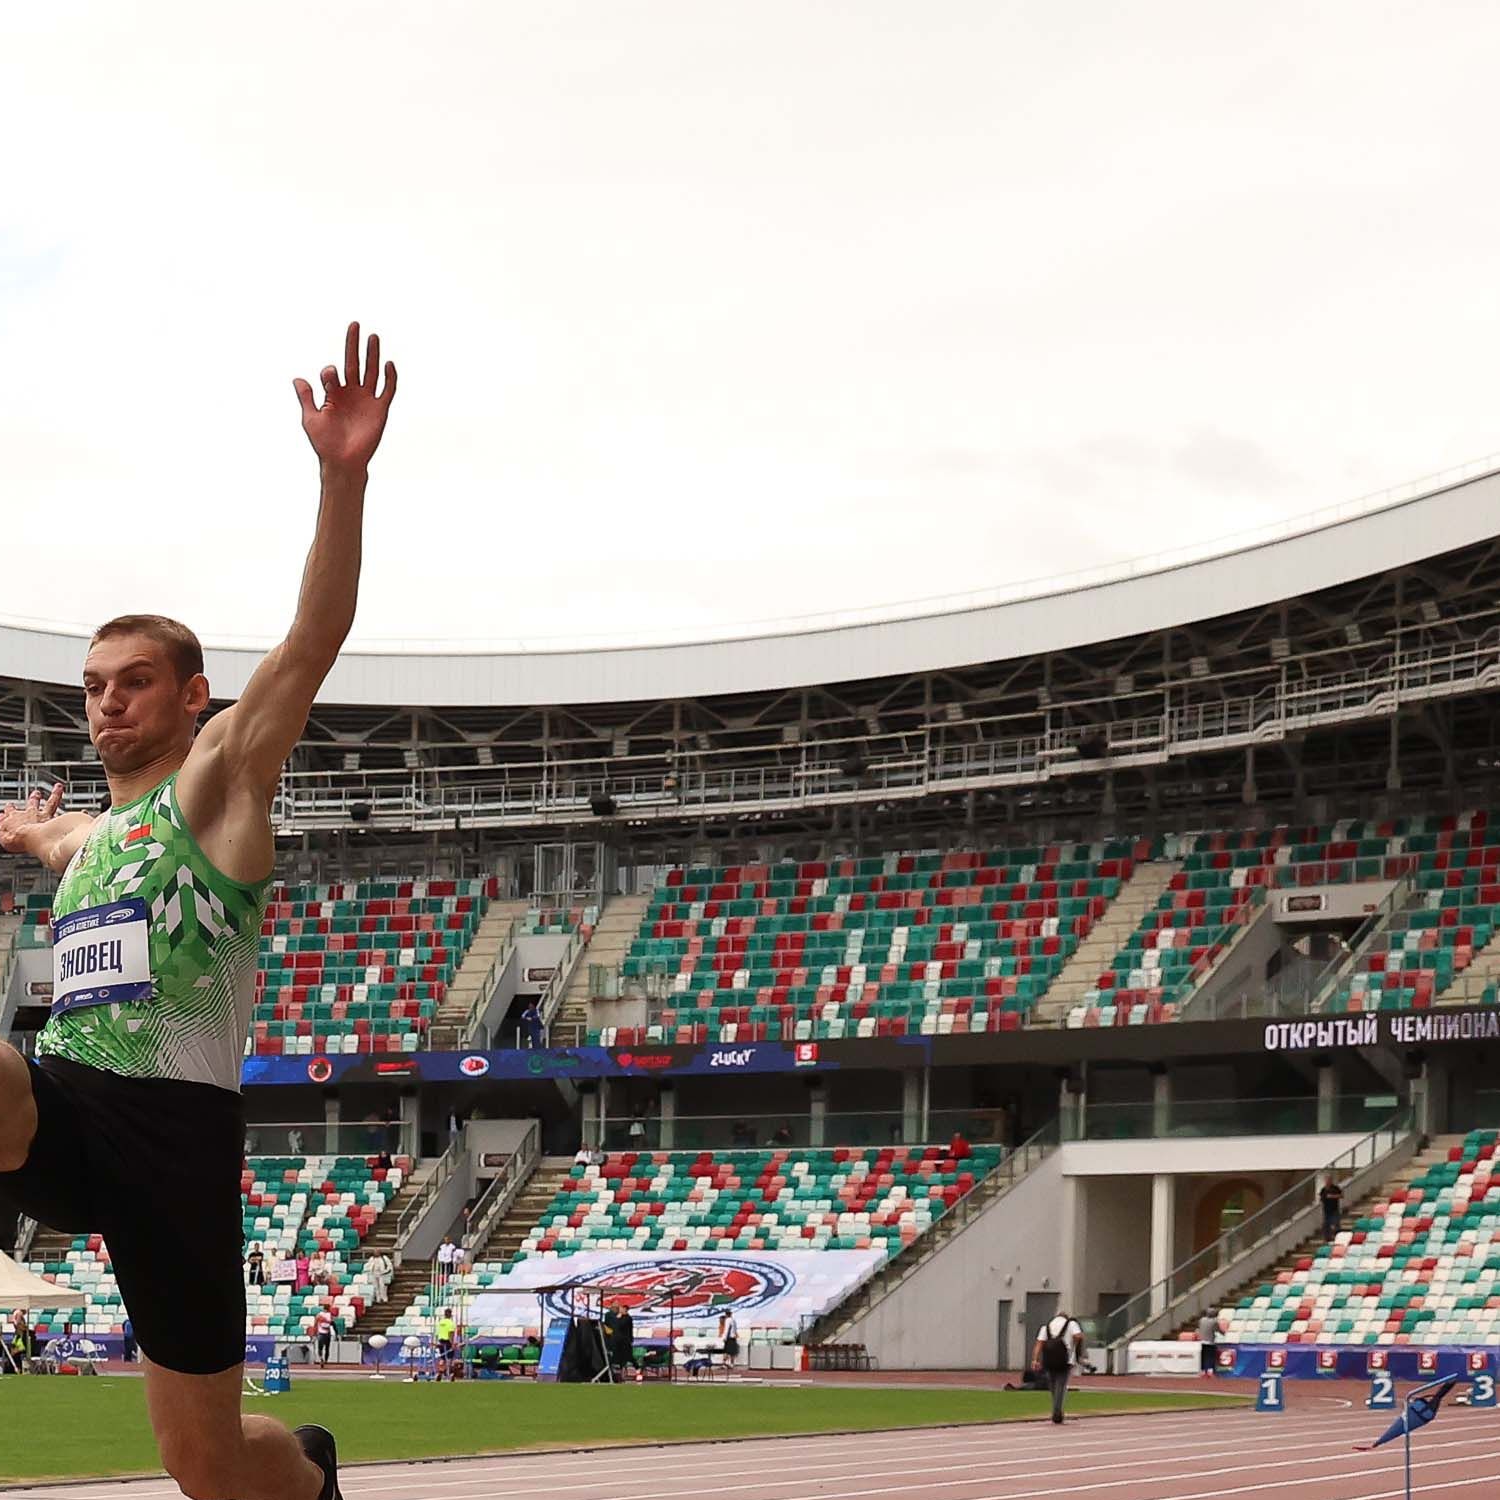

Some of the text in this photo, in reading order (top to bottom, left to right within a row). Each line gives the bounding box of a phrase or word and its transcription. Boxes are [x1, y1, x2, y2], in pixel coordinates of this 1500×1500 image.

[60, 939, 122, 982] ЗНОВЕЦ
[1264, 1012, 1500, 1050] ОТКРЫТЫЙ ЧЕМПИОНА
[800, 1045, 813, 1060] 5
[1220, 1352, 1232, 1366] 5
[1270, 1352, 1282, 1366] 5
[1322, 1352, 1334, 1366] 5
[1372, 1352, 1383, 1366] 5
[1422, 1352, 1433, 1366] 5
[1472, 1354, 1483, 1368] 5
[1261, 1378, 1280, 1406] 1
[1372, 1378, 1392, 1403] 2
[1474, 1375, 1494, 1400] 3
